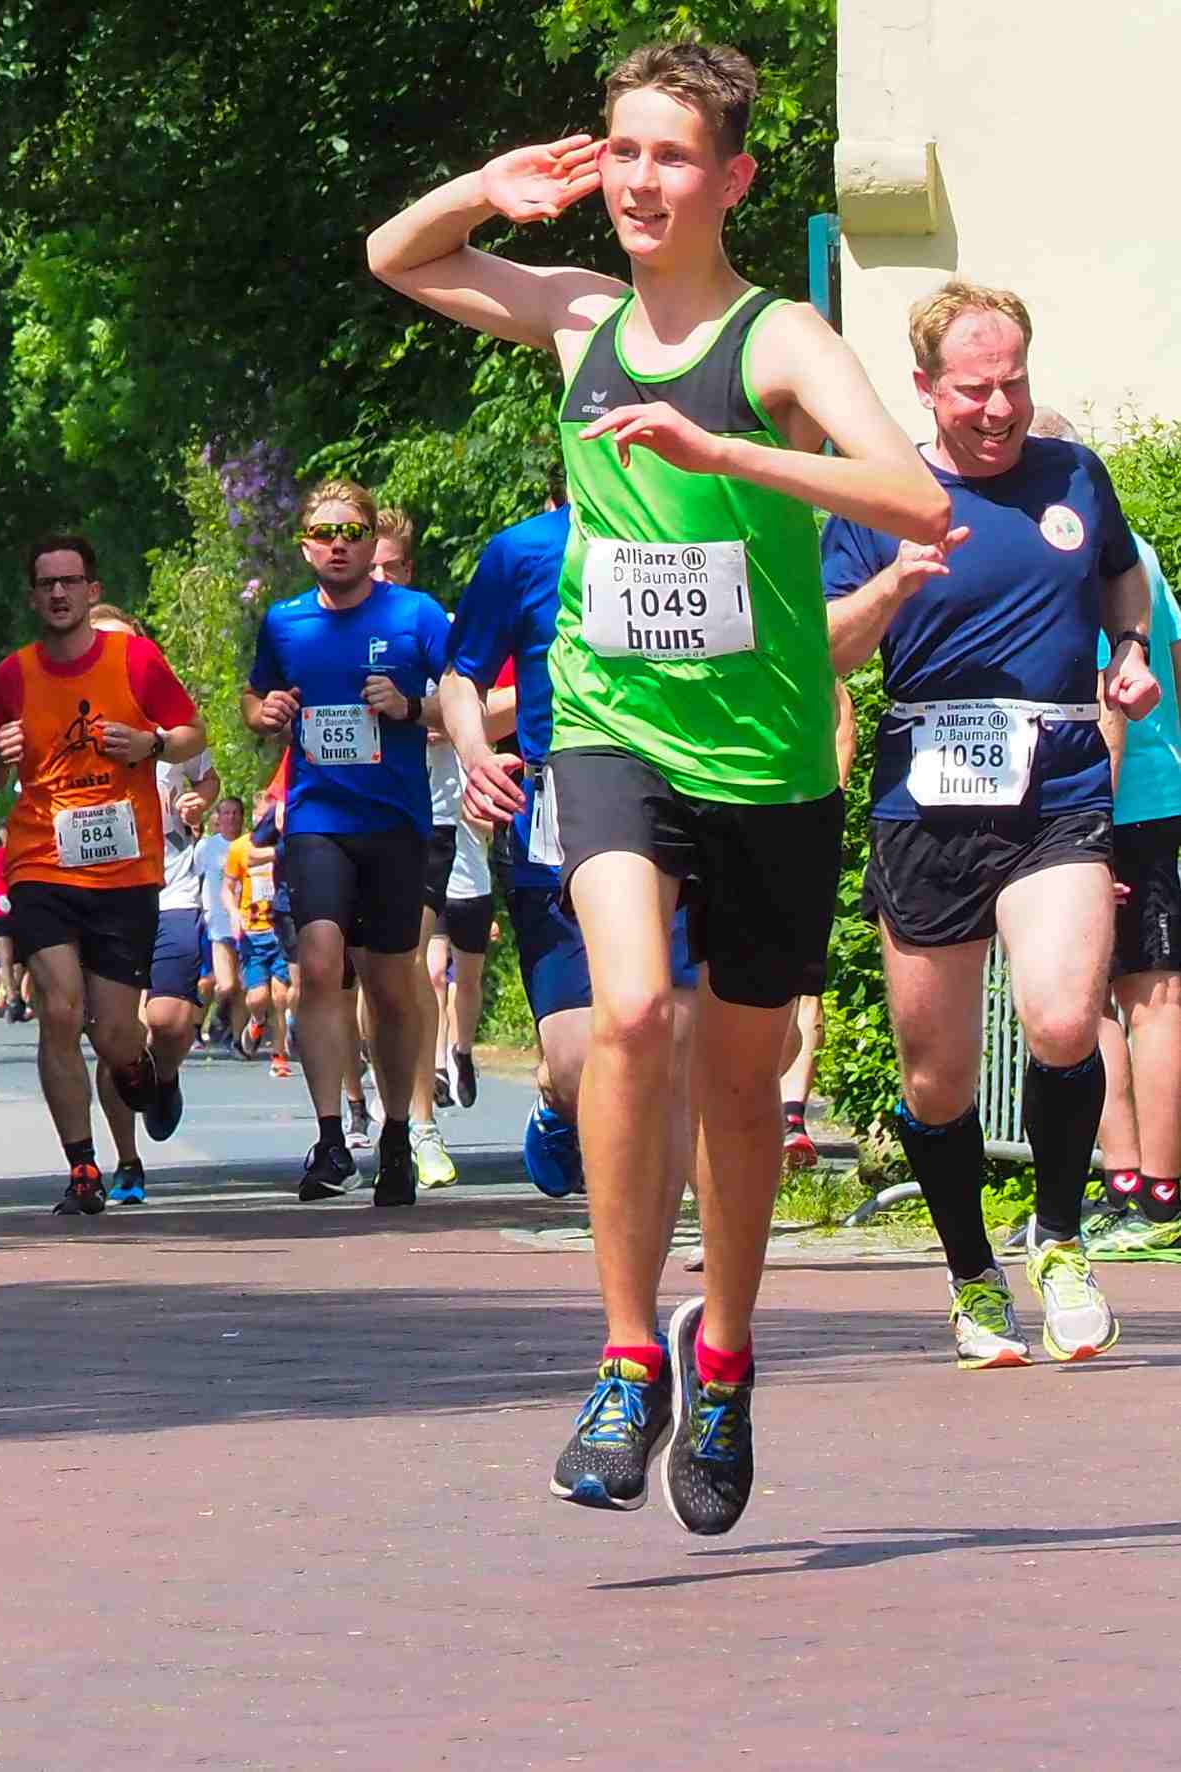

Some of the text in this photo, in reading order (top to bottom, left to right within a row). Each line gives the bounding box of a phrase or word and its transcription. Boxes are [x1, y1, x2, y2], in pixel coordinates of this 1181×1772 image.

[614, 547, 677, 566] Allianz
[633, 568, 708, 584] Baumann
[620, 588, 707, 617] 1049
[626, 621, 706, 650] bruns
[936, 711, 985, 728] Allianz
[323, 727, 355, 743] 655
[949, 730, 1008, 742] Baumann
[321, 744, 357, 760] bruns
[937, 744, 1004, 768] 1058
[939, 772, 999, 795] bruns
[82, 826, 114, 843] 884
[80, 844, 118, 860] bruns
